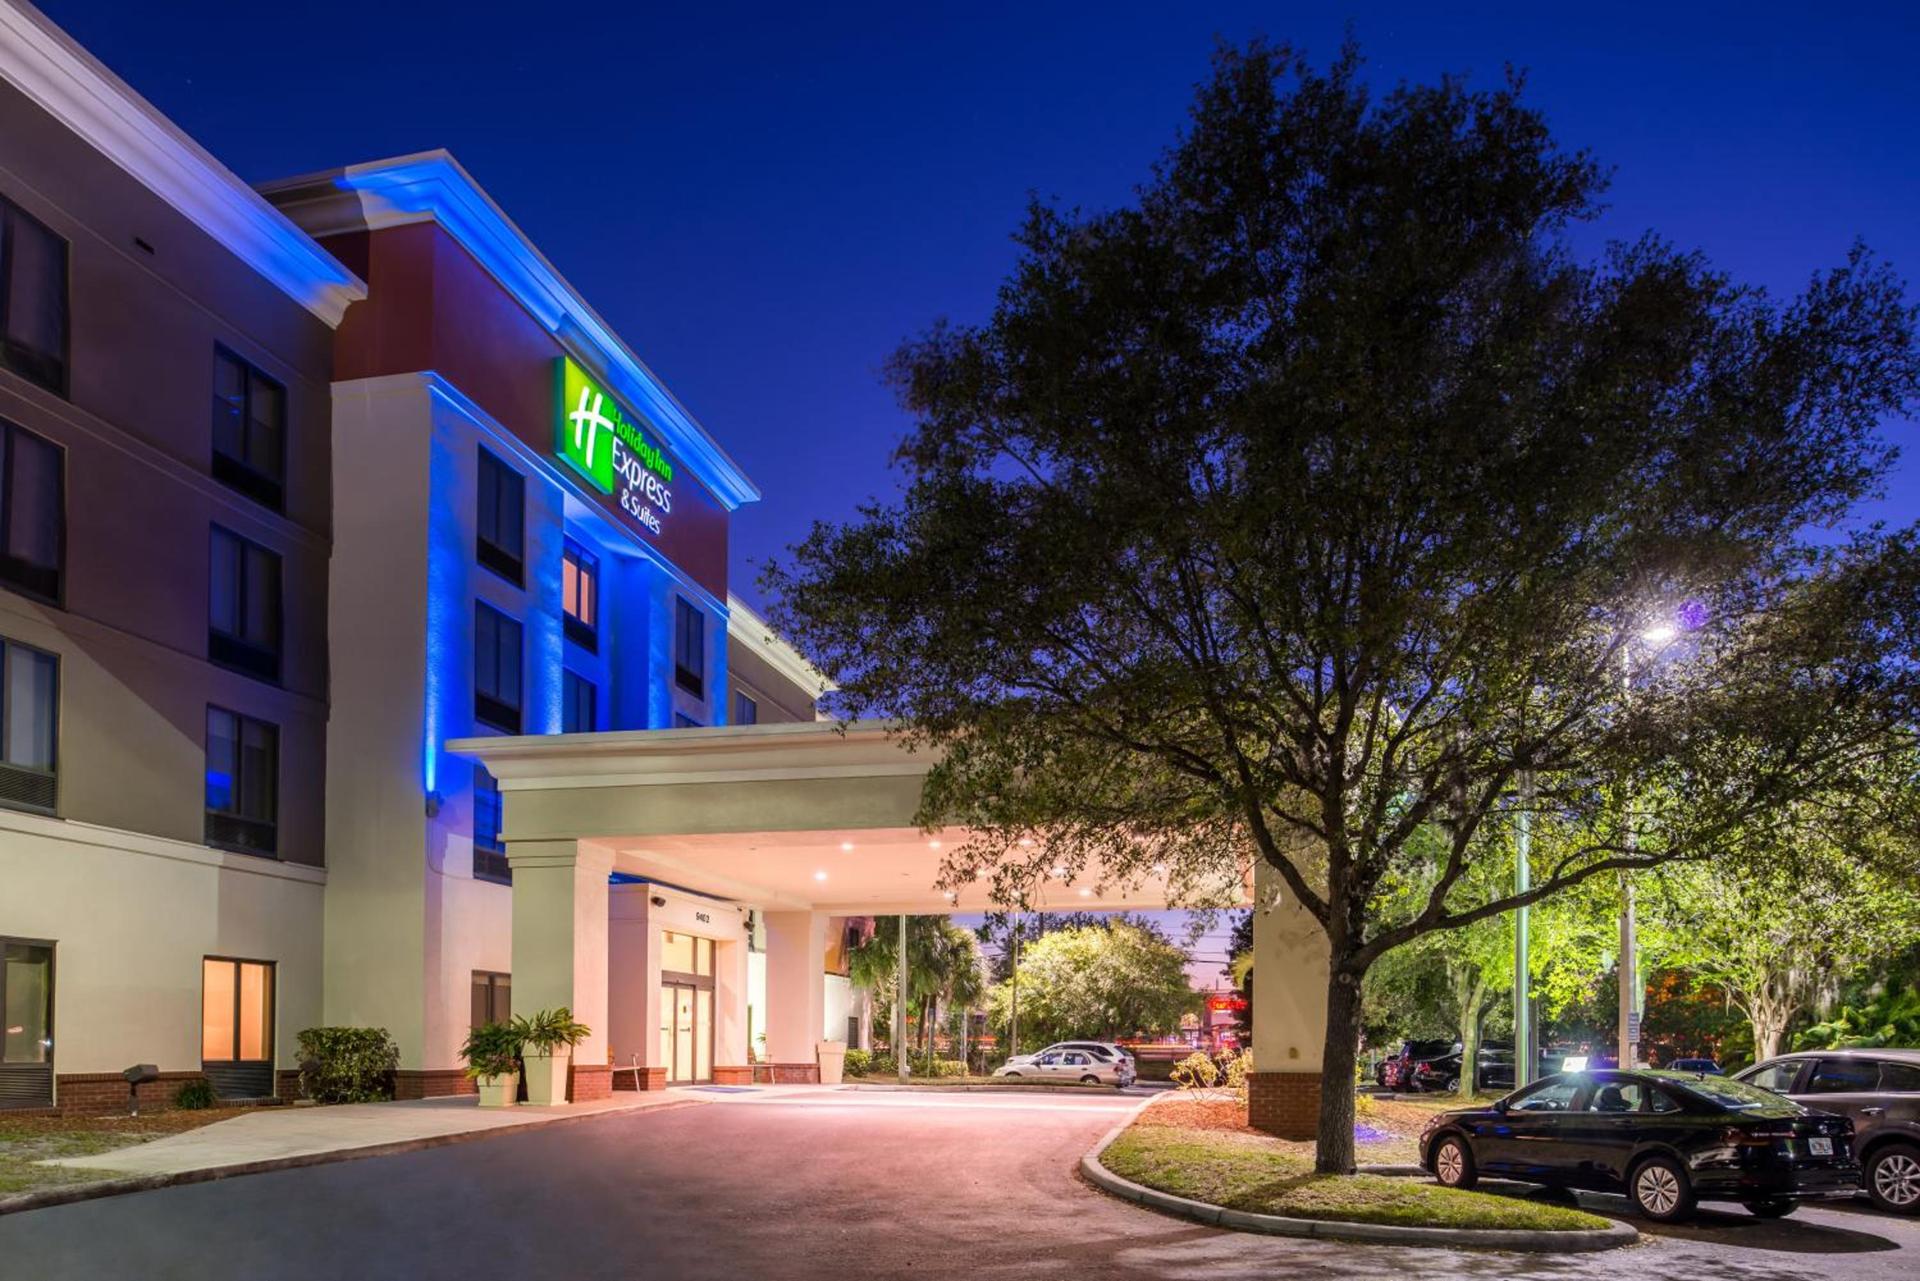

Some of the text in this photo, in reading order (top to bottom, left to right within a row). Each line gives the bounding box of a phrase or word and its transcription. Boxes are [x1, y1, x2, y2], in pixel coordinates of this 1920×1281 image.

[612, 435, 672, 513] Express
[614, 408, 672, 481] Holiday Inn
[621, 488, 660, 534] & Suites
